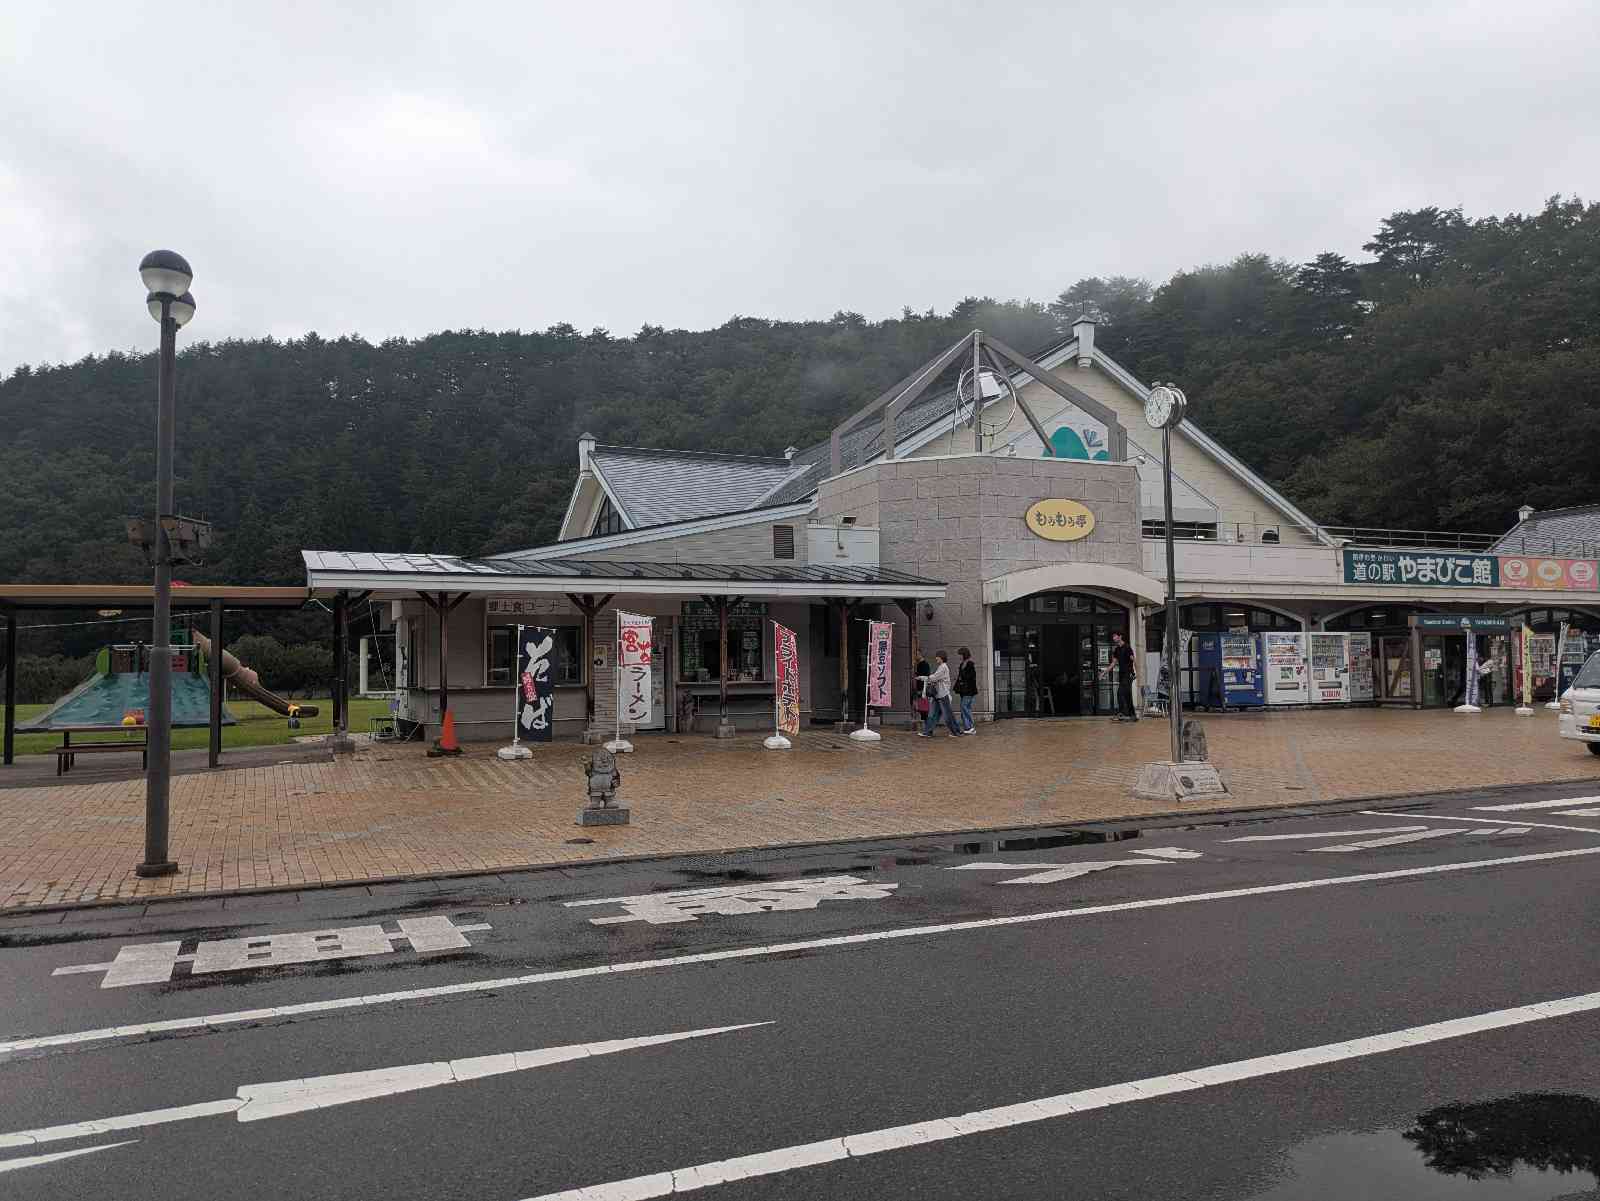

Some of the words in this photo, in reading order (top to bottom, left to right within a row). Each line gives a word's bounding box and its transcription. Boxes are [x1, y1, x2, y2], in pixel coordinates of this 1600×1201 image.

[1353, 563, 1397, 582] 道の駅
[1397, 556, 1492, 585] やまびこ館
[521, 635, 553, 731] そば
[1321, 690, 1342, 698] KIRIN
